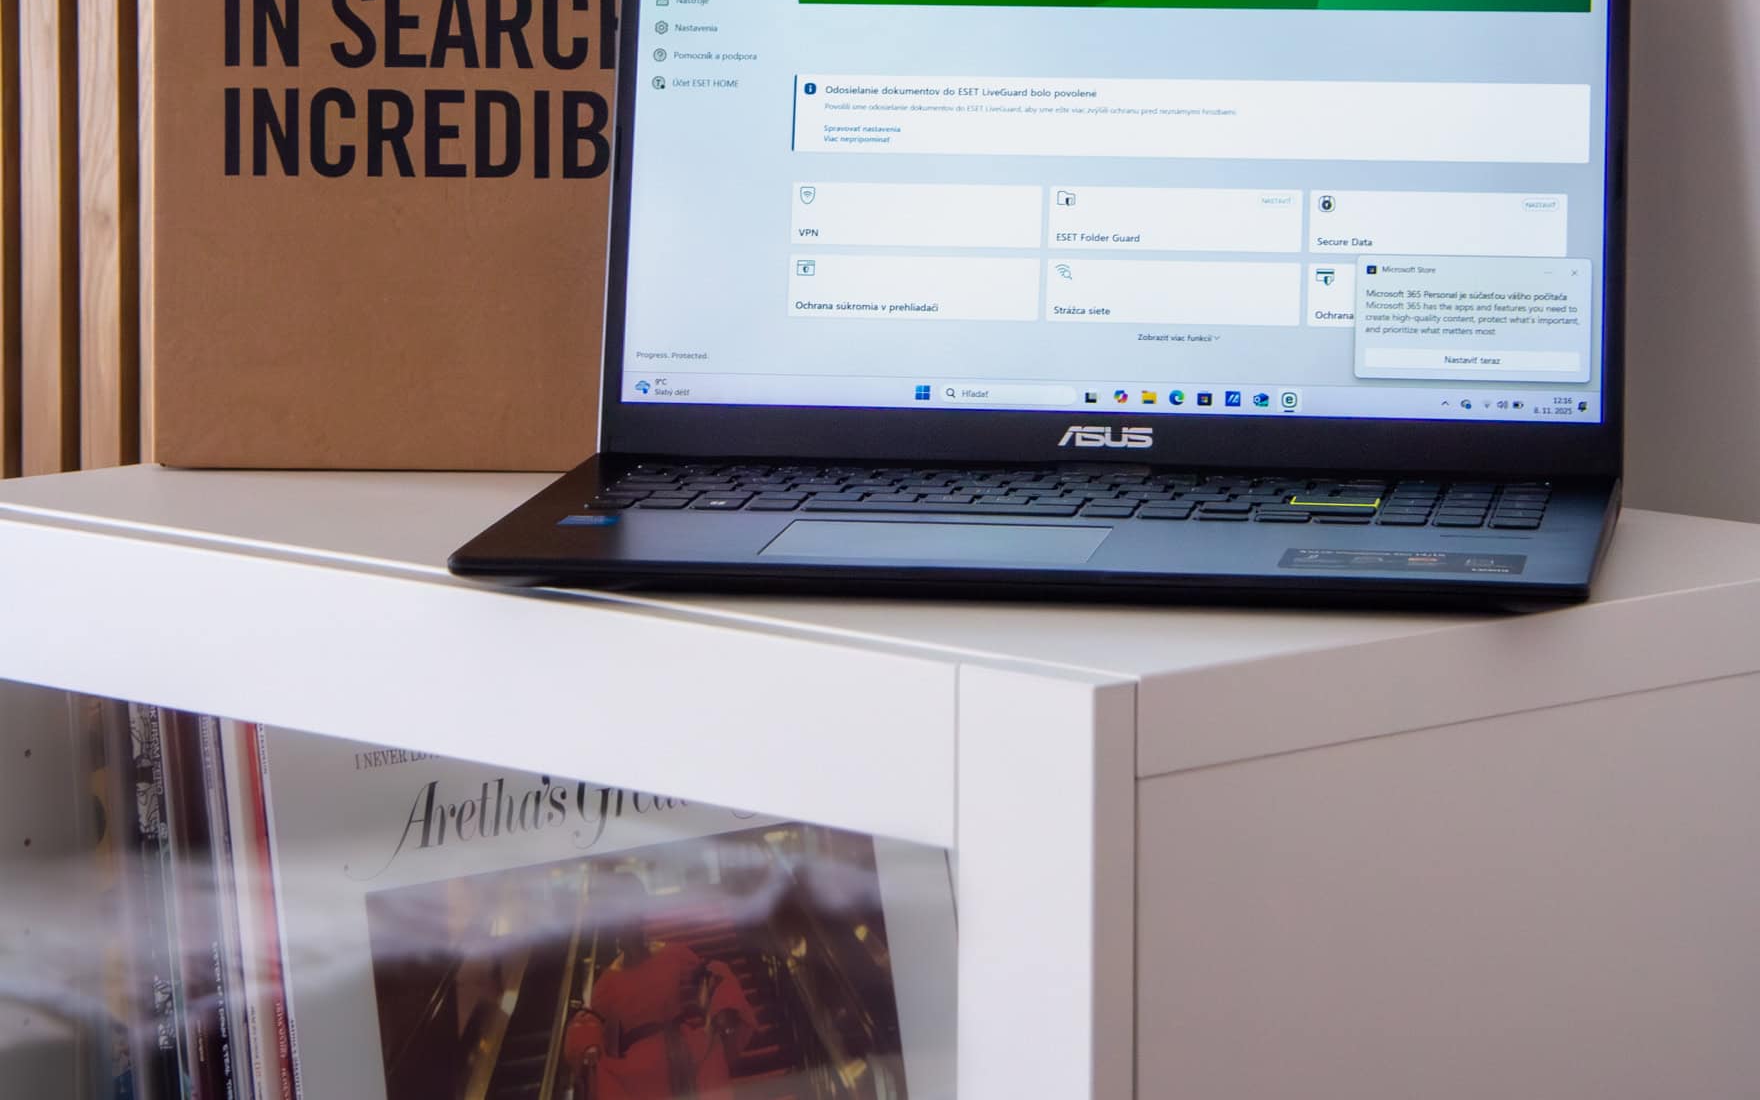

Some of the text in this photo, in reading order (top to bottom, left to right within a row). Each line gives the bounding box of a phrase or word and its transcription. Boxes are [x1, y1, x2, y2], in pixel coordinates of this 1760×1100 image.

[674, 24, 718, 32] Nastavenia
[722, 52, 758, 61] podpora
[692, 79, 710, 88] ESET
[713, 80, 739, 88] HOME
[825, 86, 878, 94] Odosielanie
[882, 86, 940, 96] dokumentov
[943, 88, 955, 96] do
[958, 88, 979, 96] ESET
[982, 88, 1028, 97] LiveGuard
[1030, 88, 1051, 97] bolo
[224, 87, 610, 179] INCREDIB
[798, 228, 819, 237] VPN
[1056, 233, 1140, 243] ESET Folder Guard
[1317, 238, 1373, 246] Secure Data
[1382, 266, 1415, 274] Microsoft
[1366, 290, 1404, 298] Microsoft
[1407, 290, 1421, 298] 365
[1424, 291, 1458, 299] Personal
[795, 301, 833, 310] Ochrana
[836, 302, 878, 311] súkromia
[889, 302, 939, 314] prehliadači
[1088, 307, 1111, 315] siete
[1366, 302, 1404, 310] Microsoft
[1406, 302, 1421, 310] 365
[1455, 304, 1474, 312] apps
[1476, 304, 1491, 312] and
[1494, 304, 1526, 312] features
[1528, 306, 1544, 314] you
[1315, 311, 1354, 320] Ochrana
[1392, 314, 1440, 324] high-quality
[1478, 316, 1507, 324] protect
[1383, 327, 1418, 335] prioritize
[1480, 357, 1500, 365] teraz
[1057, 426, 1153, 448] ASUS
[354, 754, 360, 770] I
[363, 750, 408, 768] NEVER
[344, 776, 567, 881] Aretha's
